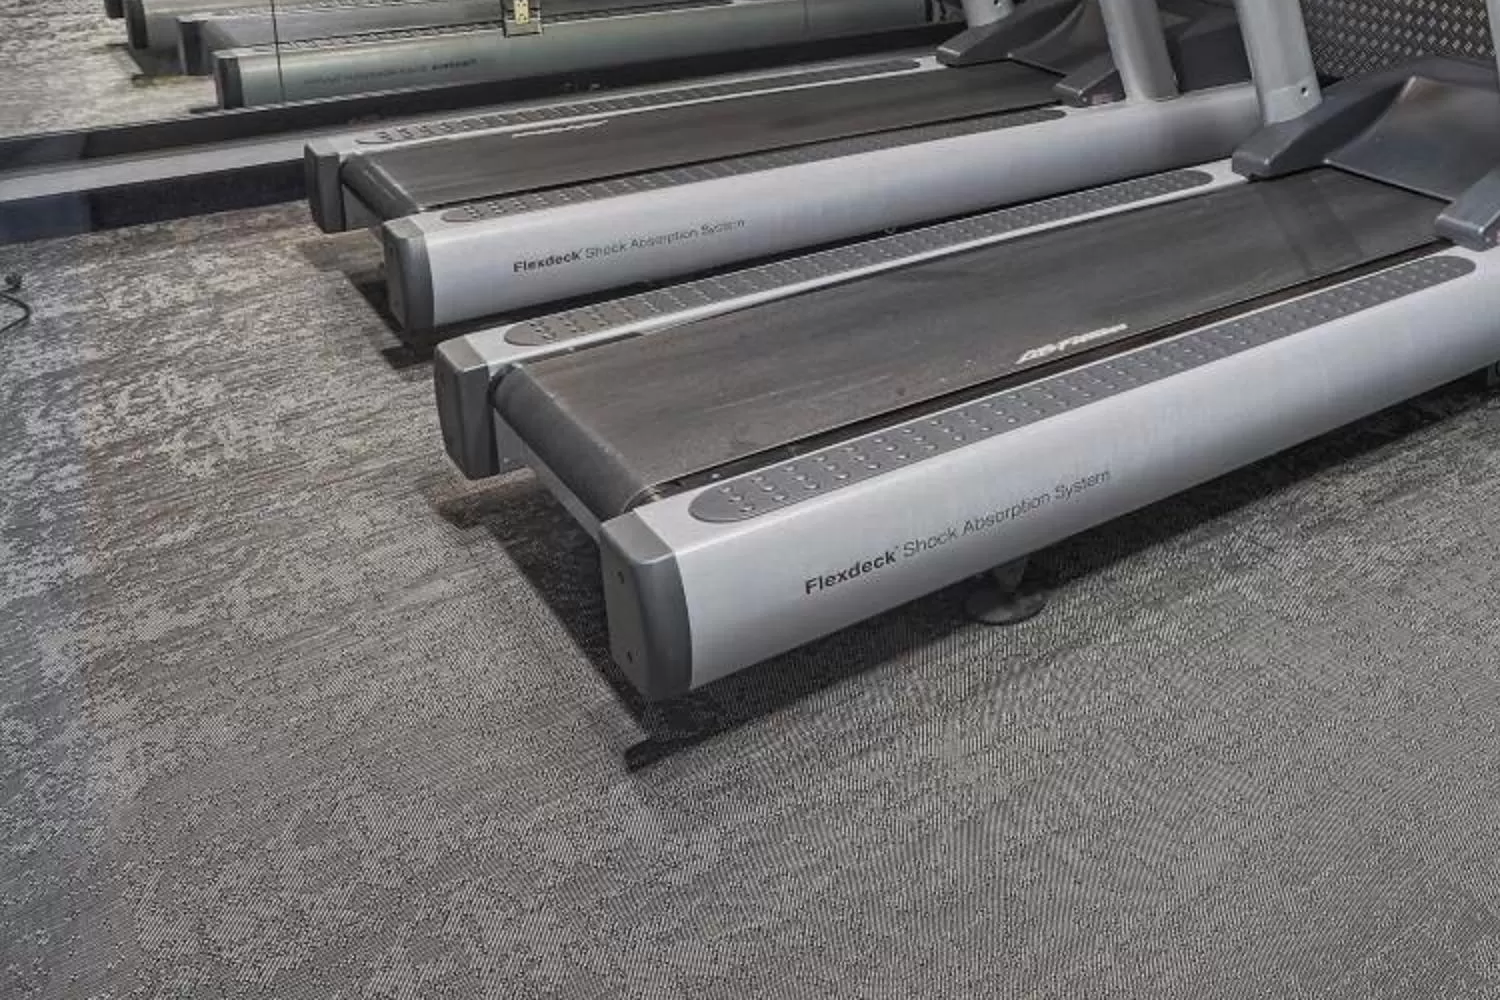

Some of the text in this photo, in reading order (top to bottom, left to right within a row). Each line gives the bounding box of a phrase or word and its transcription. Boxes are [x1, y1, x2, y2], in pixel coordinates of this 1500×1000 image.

[805, 470, 1111, 595] Flexdeck Shock Absorption System
